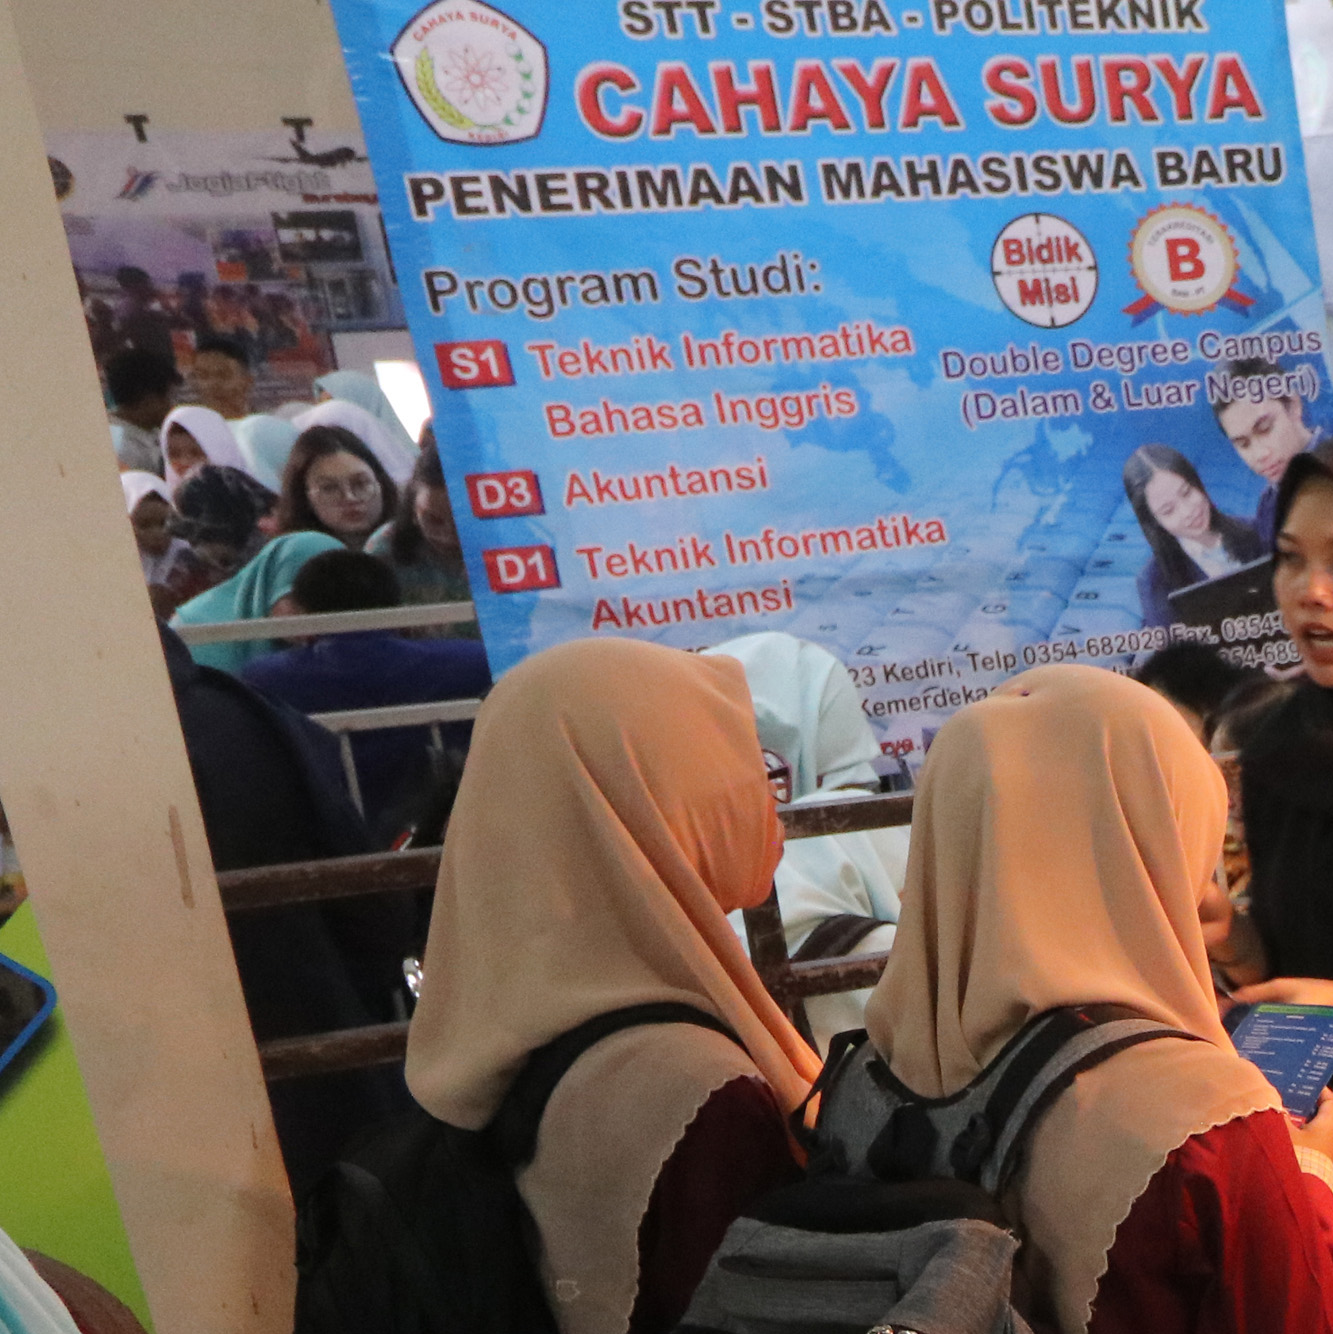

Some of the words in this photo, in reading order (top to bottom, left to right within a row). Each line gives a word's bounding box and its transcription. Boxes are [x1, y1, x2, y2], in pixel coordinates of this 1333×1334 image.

[623, 0, 715, 37] STT
[767, 0, 893, 35] STBA
[936, 0, 1205, 34] POLITEKNIK
[577, 58, 961, 138] CAHAYA
[984, 54, 1263, 126] SURYA
[409, 164, 801, 218] PENERIMAAN
[822, 154, 1141, 199] MAHASISWA
[1158, 147, 1283, 187] BARU
[1002, 234, 1083, 267] Bidik
[1165, 237, 1206, 282] B
[425, 270, 657, 318] Program
[675, 256, 822, 299] Studi:
[1017, 275, 1080, 308] Misi
[449, 347, 502, 381] S1
[529, 336, 672, 380] Teknik
[685, 325, 912, 367] Informatika
[942, 341, 1061, 379] Double
[1071, 336, 1190, 373] Degree
[1199, 327, 1322, 362] Campus
[547, 401, 702, 438] Bahasa
[715, 383, 857, 429] Inggris
[961, 388, 1080, 429] (Dalam
[1091, 381, 1115, 409] &
[1124, 378, 1197, 408] Luar
[1207, 366, 1318, 403] Negeri)
[476, 478, 532, 511] D3
[565, 457, 769, 507] Akuntansi
[495, 551, 548, 585] D1
[577, 537, 715, 580] Teknik
[725, 516, 948, 565] Informatika
[592, 580, 794, 631] Akuntansi
[884, 658, 961, 686] Kediri,
[967, 650, 1017, 676] Telp
[1023, 627, 1168, 664] 0354-682029
